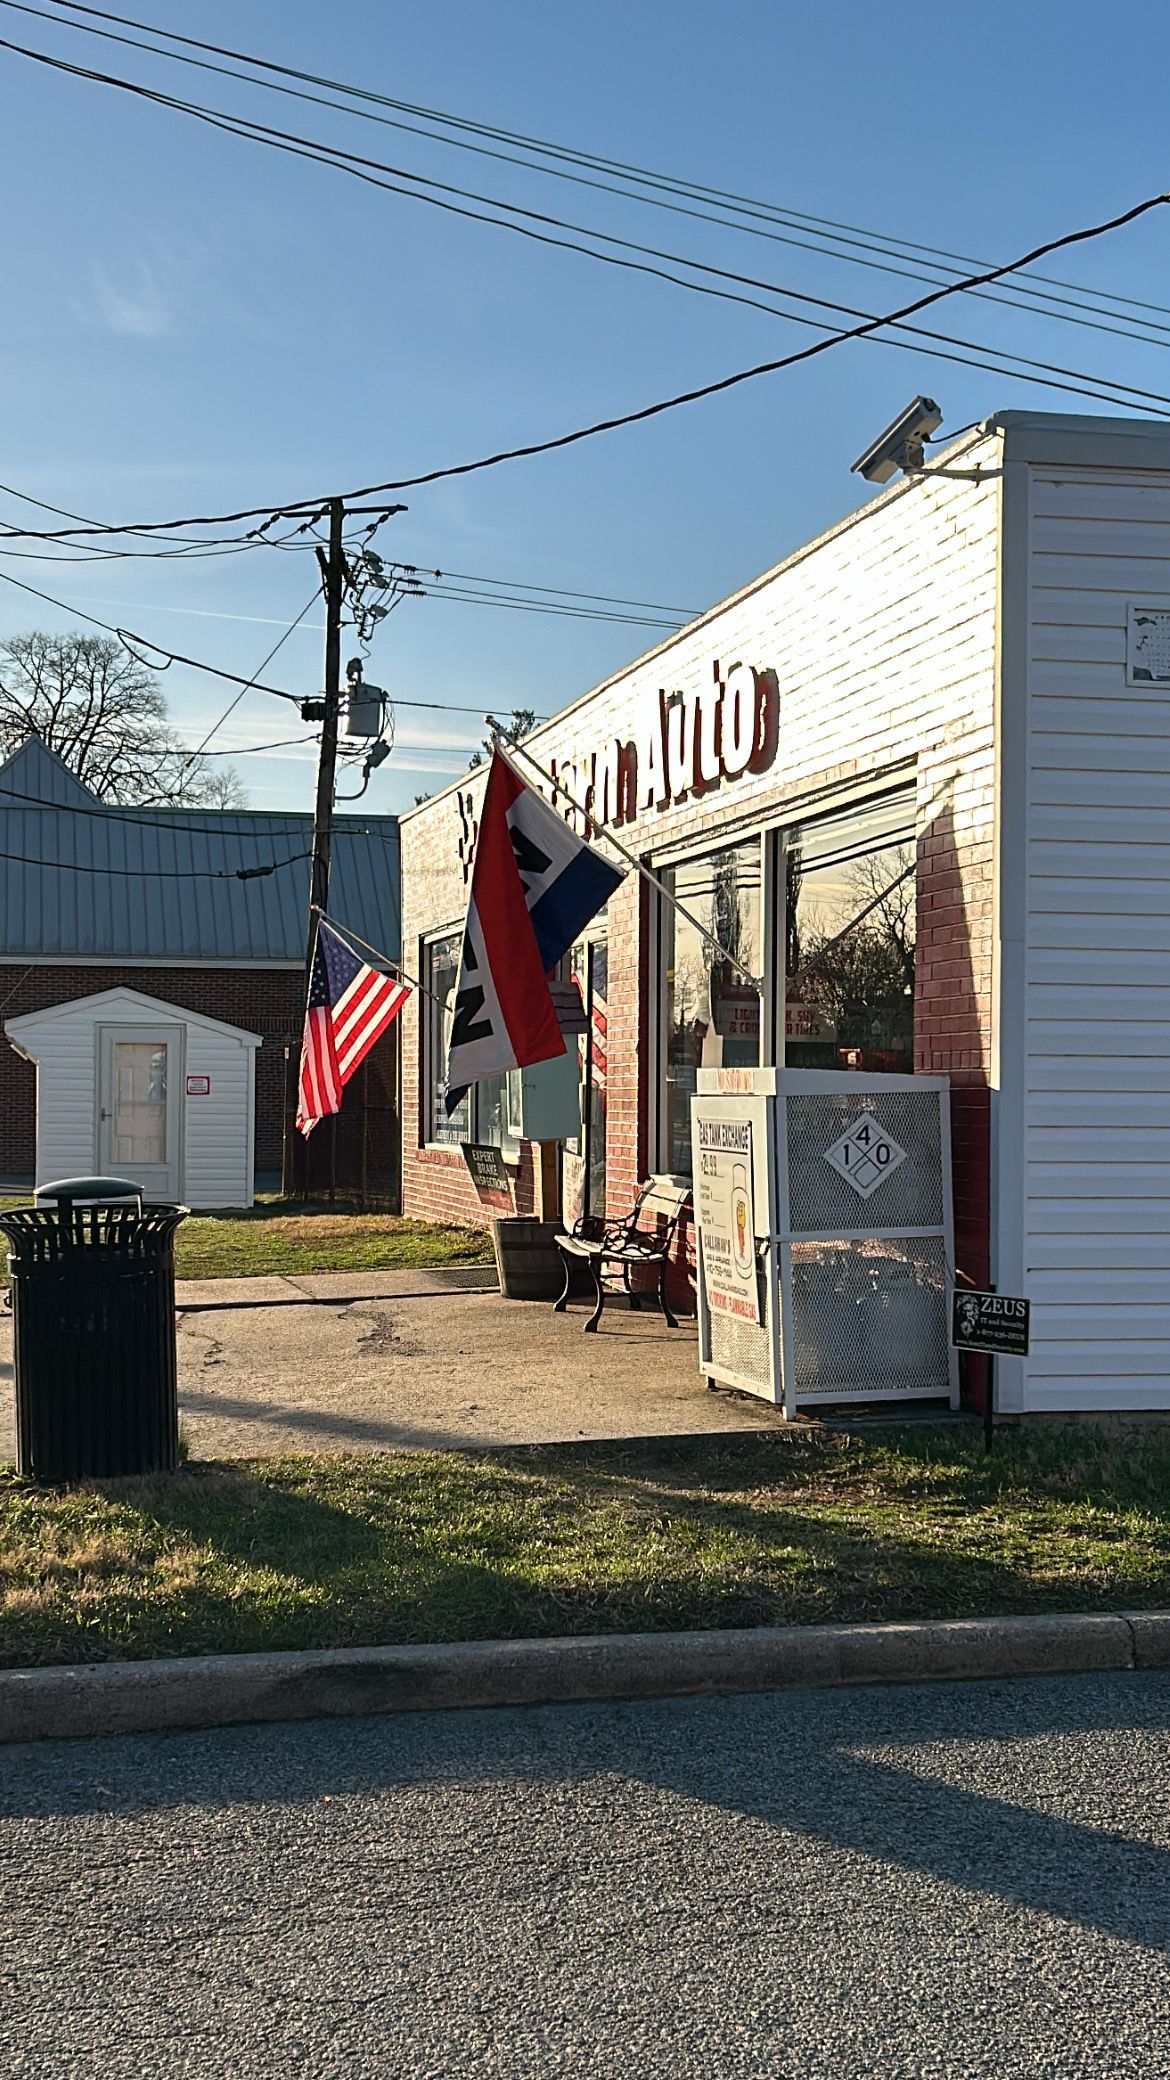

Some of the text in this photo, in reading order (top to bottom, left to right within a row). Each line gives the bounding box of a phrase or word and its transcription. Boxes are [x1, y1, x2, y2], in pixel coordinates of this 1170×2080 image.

[856, 1125, 870, 1146] 4
[472, 1150, 495, 1162] EXPERT
[843, 1144, 849, 1165] 1
[876, 1143, 891, 1165] 0
[477, 1163, 499, 1176] BRAKE
[981, 1296, 1026, 1317] ZEUS
